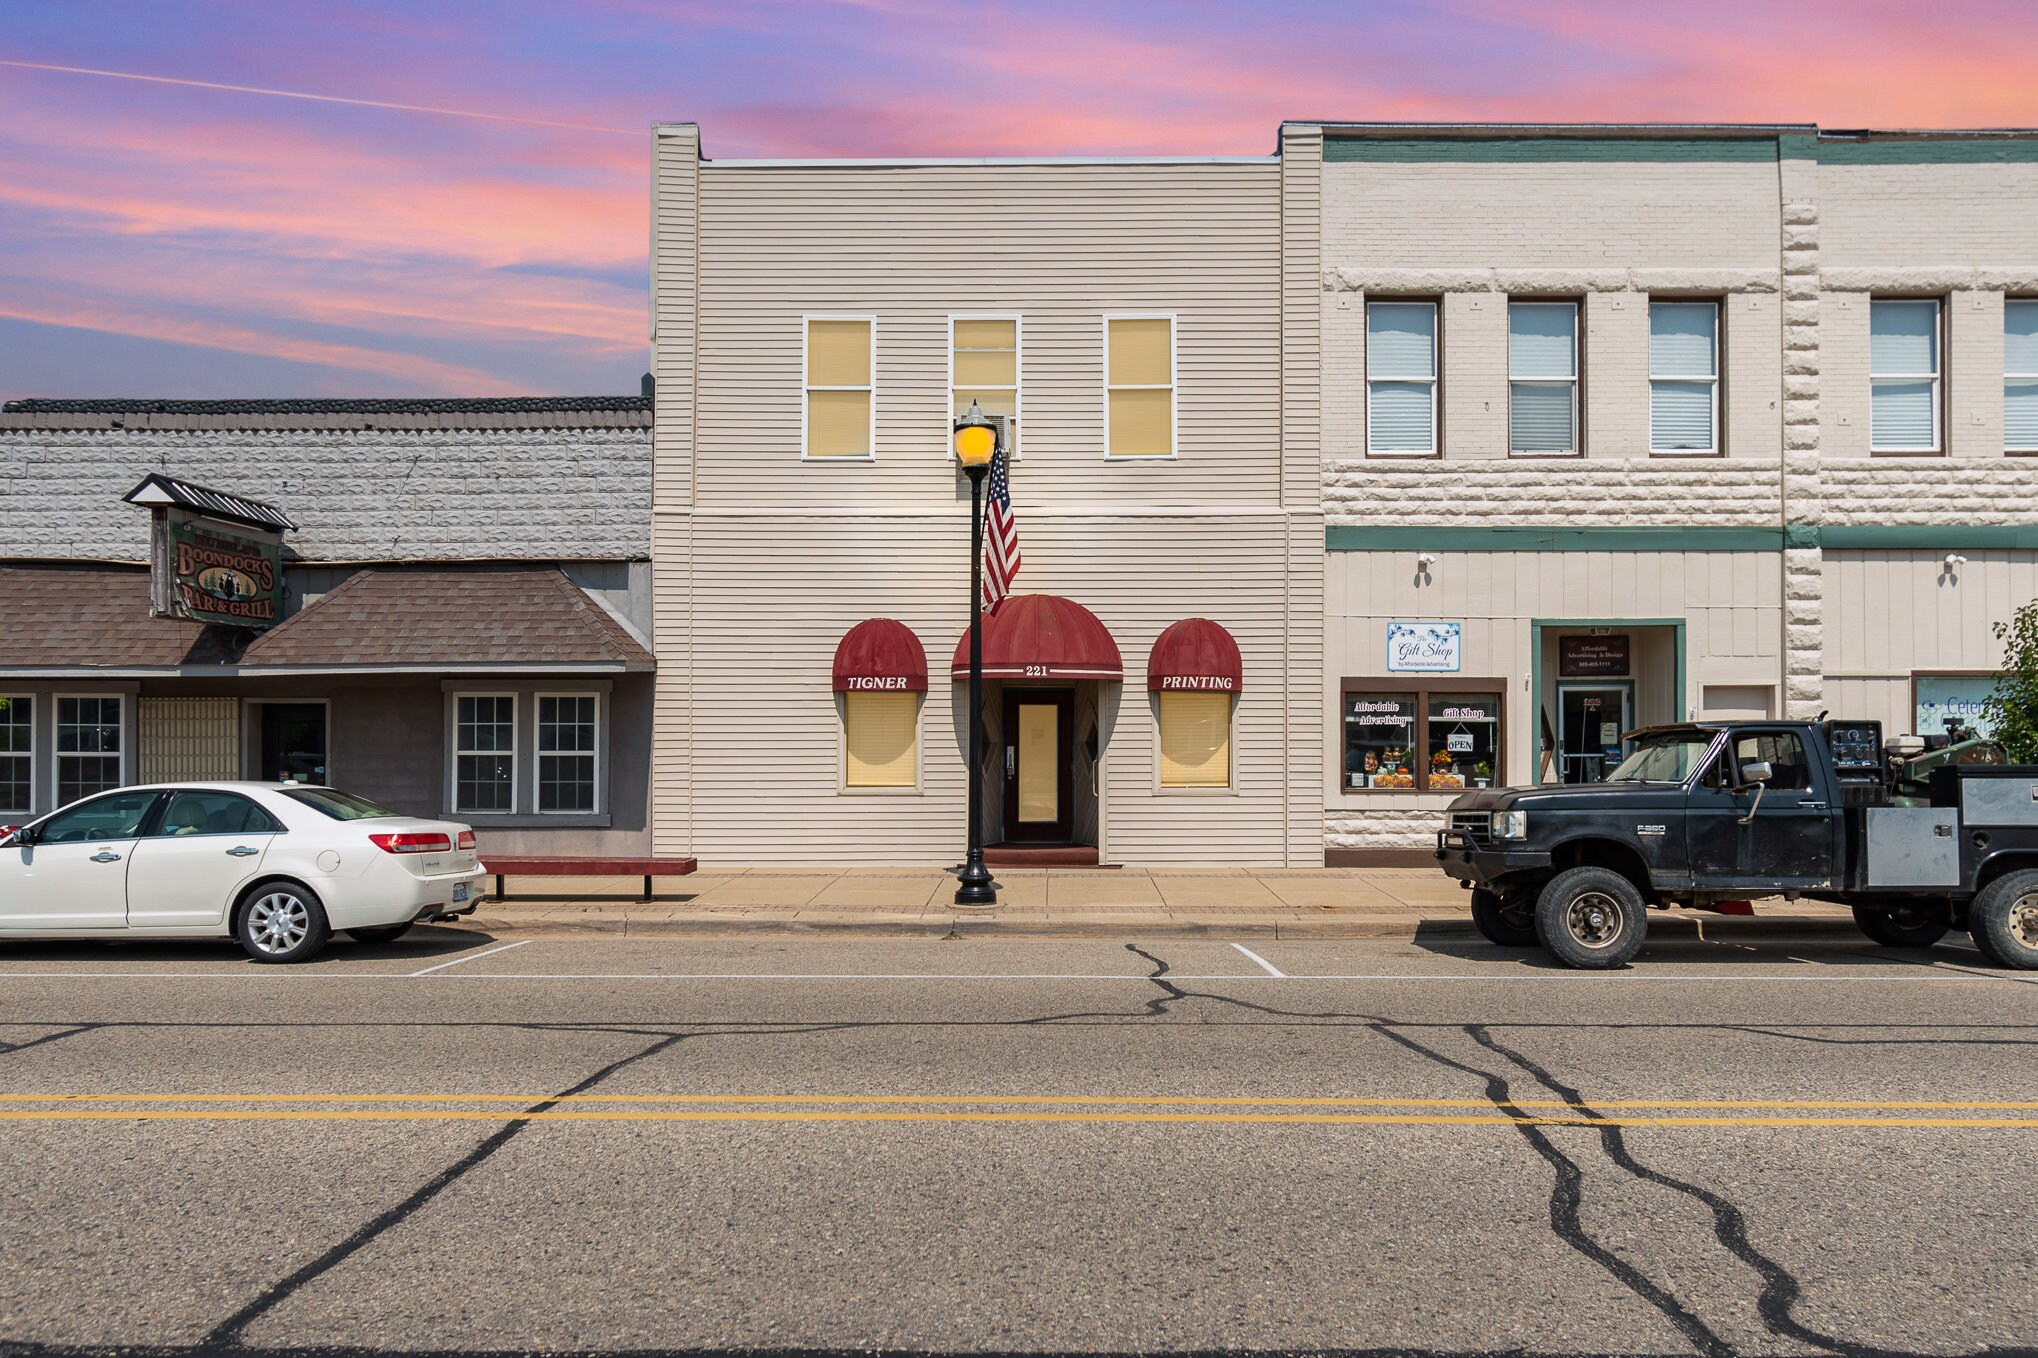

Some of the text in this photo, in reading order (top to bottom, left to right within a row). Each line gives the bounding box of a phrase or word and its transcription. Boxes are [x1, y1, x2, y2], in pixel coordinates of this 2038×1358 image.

[177, 543, 274, 590] BOONDOCKS
[181, 584, 274, 618] BAR & GRILL
[1398, 642, 1453, 660] Gift Shop
[1026, 665, 1047, 677] 221
[848, 676, 907, 689] TIGNER
[1162, 676, 1233, 689] PRINTING
[1354, 701, 1400, 712] Affordable
[1947, 697, 1985, 714] Ceter
[1443, 707, 1485, 720] Gift Shop
[1360, 714, 1407, 728] Advertising
[1448, 741, 1472, 750] OPEN
